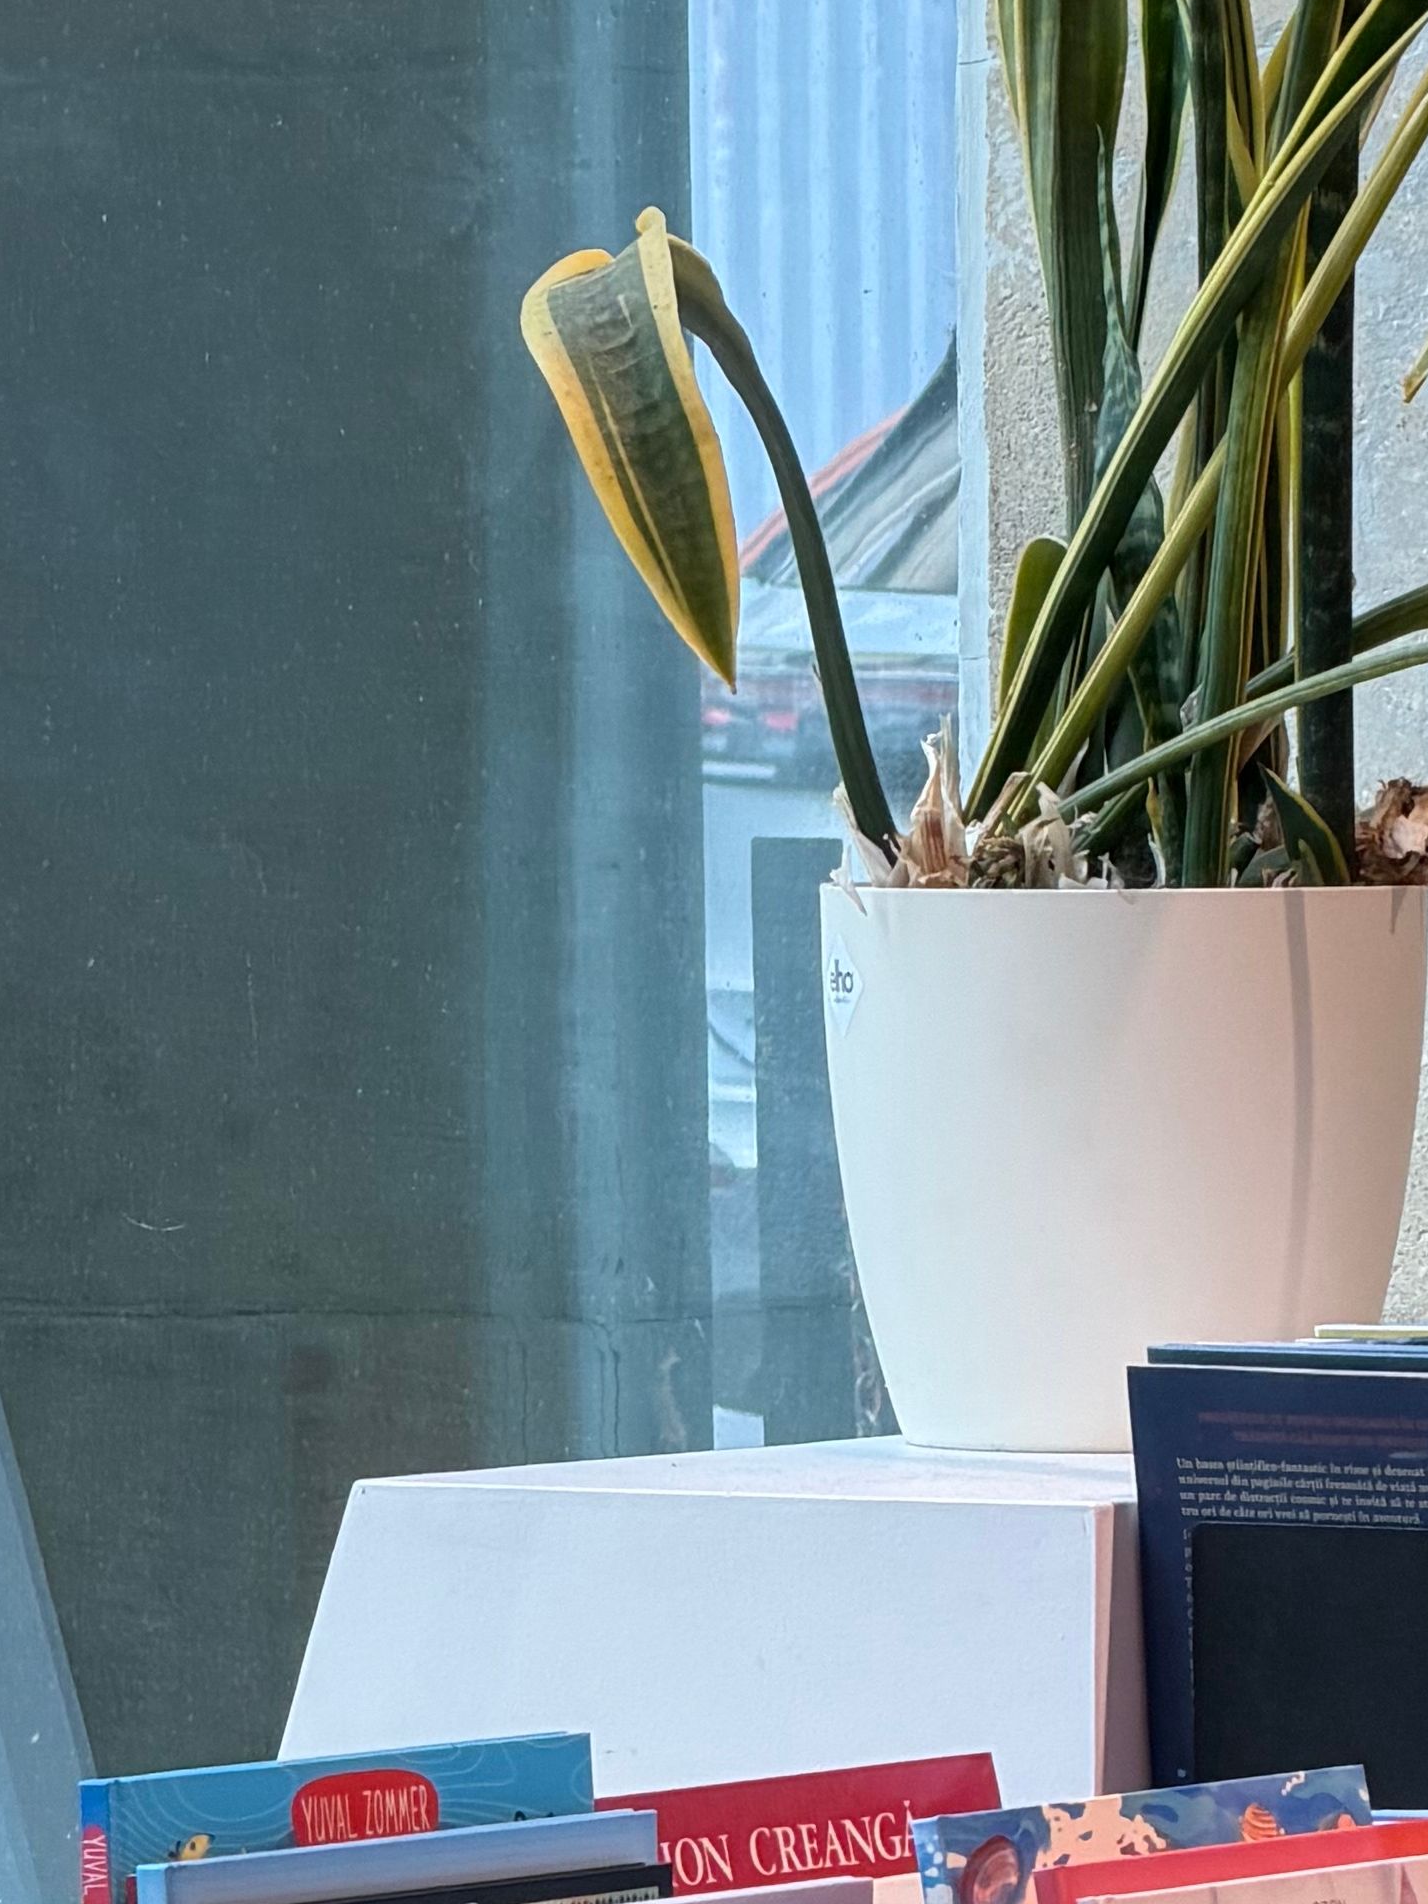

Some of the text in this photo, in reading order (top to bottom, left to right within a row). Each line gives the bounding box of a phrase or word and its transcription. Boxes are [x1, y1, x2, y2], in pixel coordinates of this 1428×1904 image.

[300, 1782, 433, 1844] YUVAL ZOMMER
[82, 1833, 111, 1897] YUVAL
